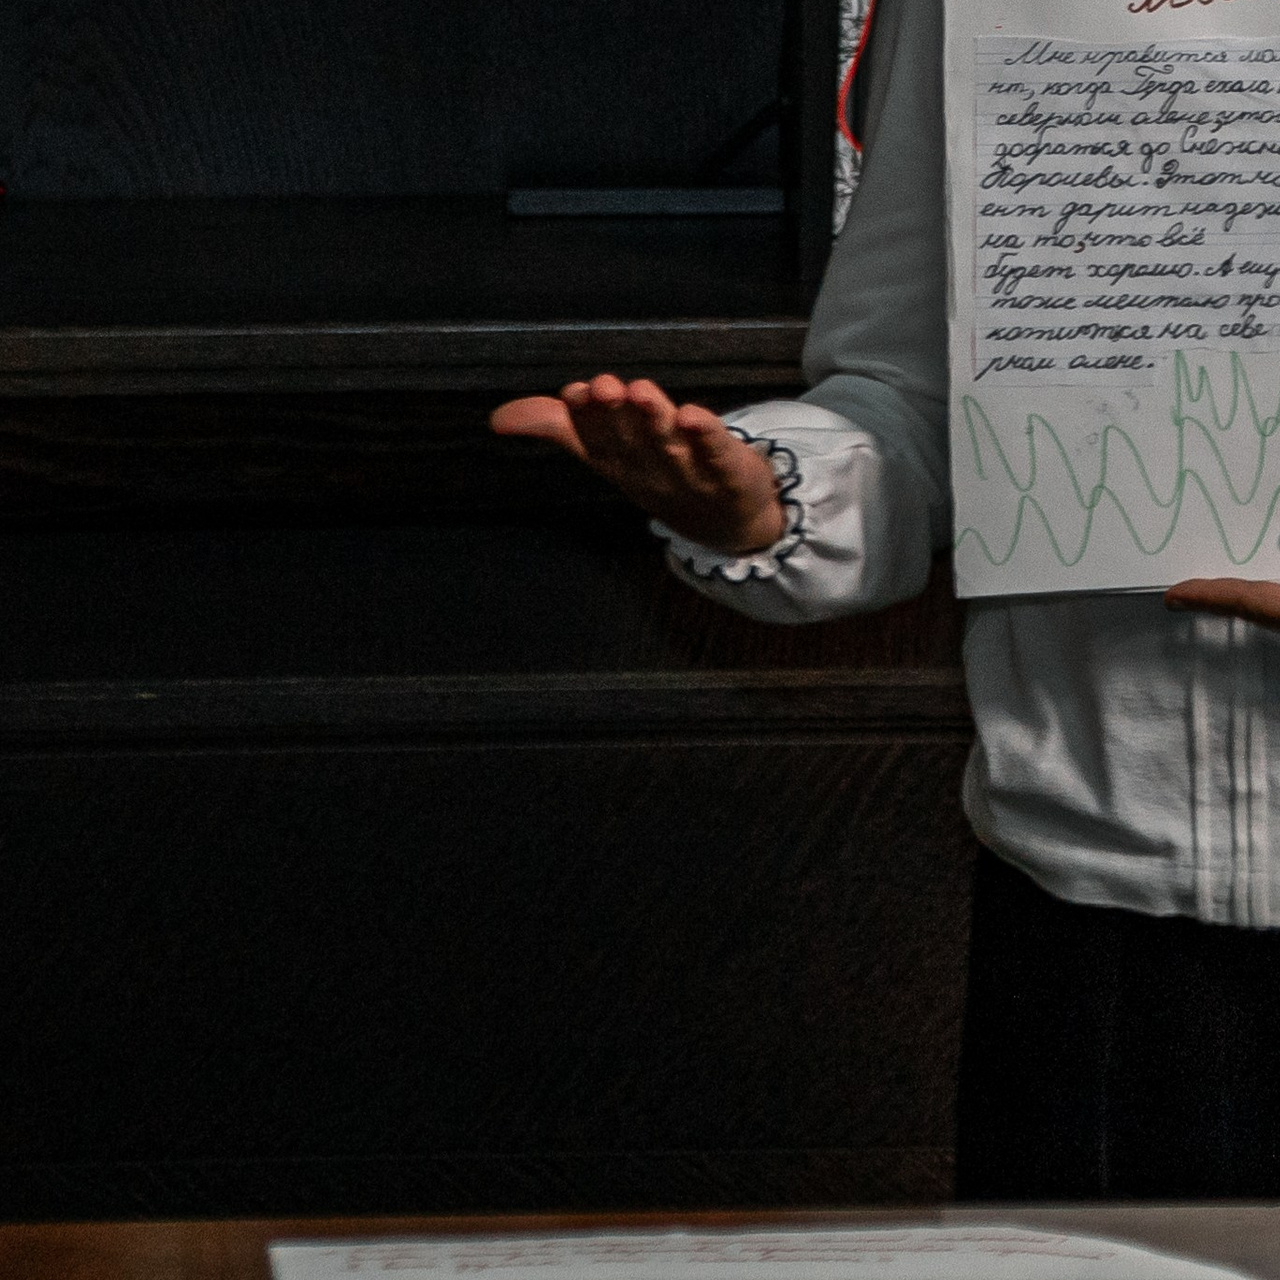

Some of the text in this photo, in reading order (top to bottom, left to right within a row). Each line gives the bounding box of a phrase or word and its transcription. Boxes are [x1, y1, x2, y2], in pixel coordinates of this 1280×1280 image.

[1004, 41, 1076, 65] Мне
[1041, 81, 1114, 110] когда
[1121, 64, 1200, 113] Герда
[1204, 80, 1273, 94] ехала
[1139, 142, 1171, 173] до
[1054, 201, 1177, 235] дарит
[979, 233, 1025, 249] на
[983, 252, 1076, 296] будет
[991, 295, 1077, 310] тоже
[1156, 322, 1208, 340] на
